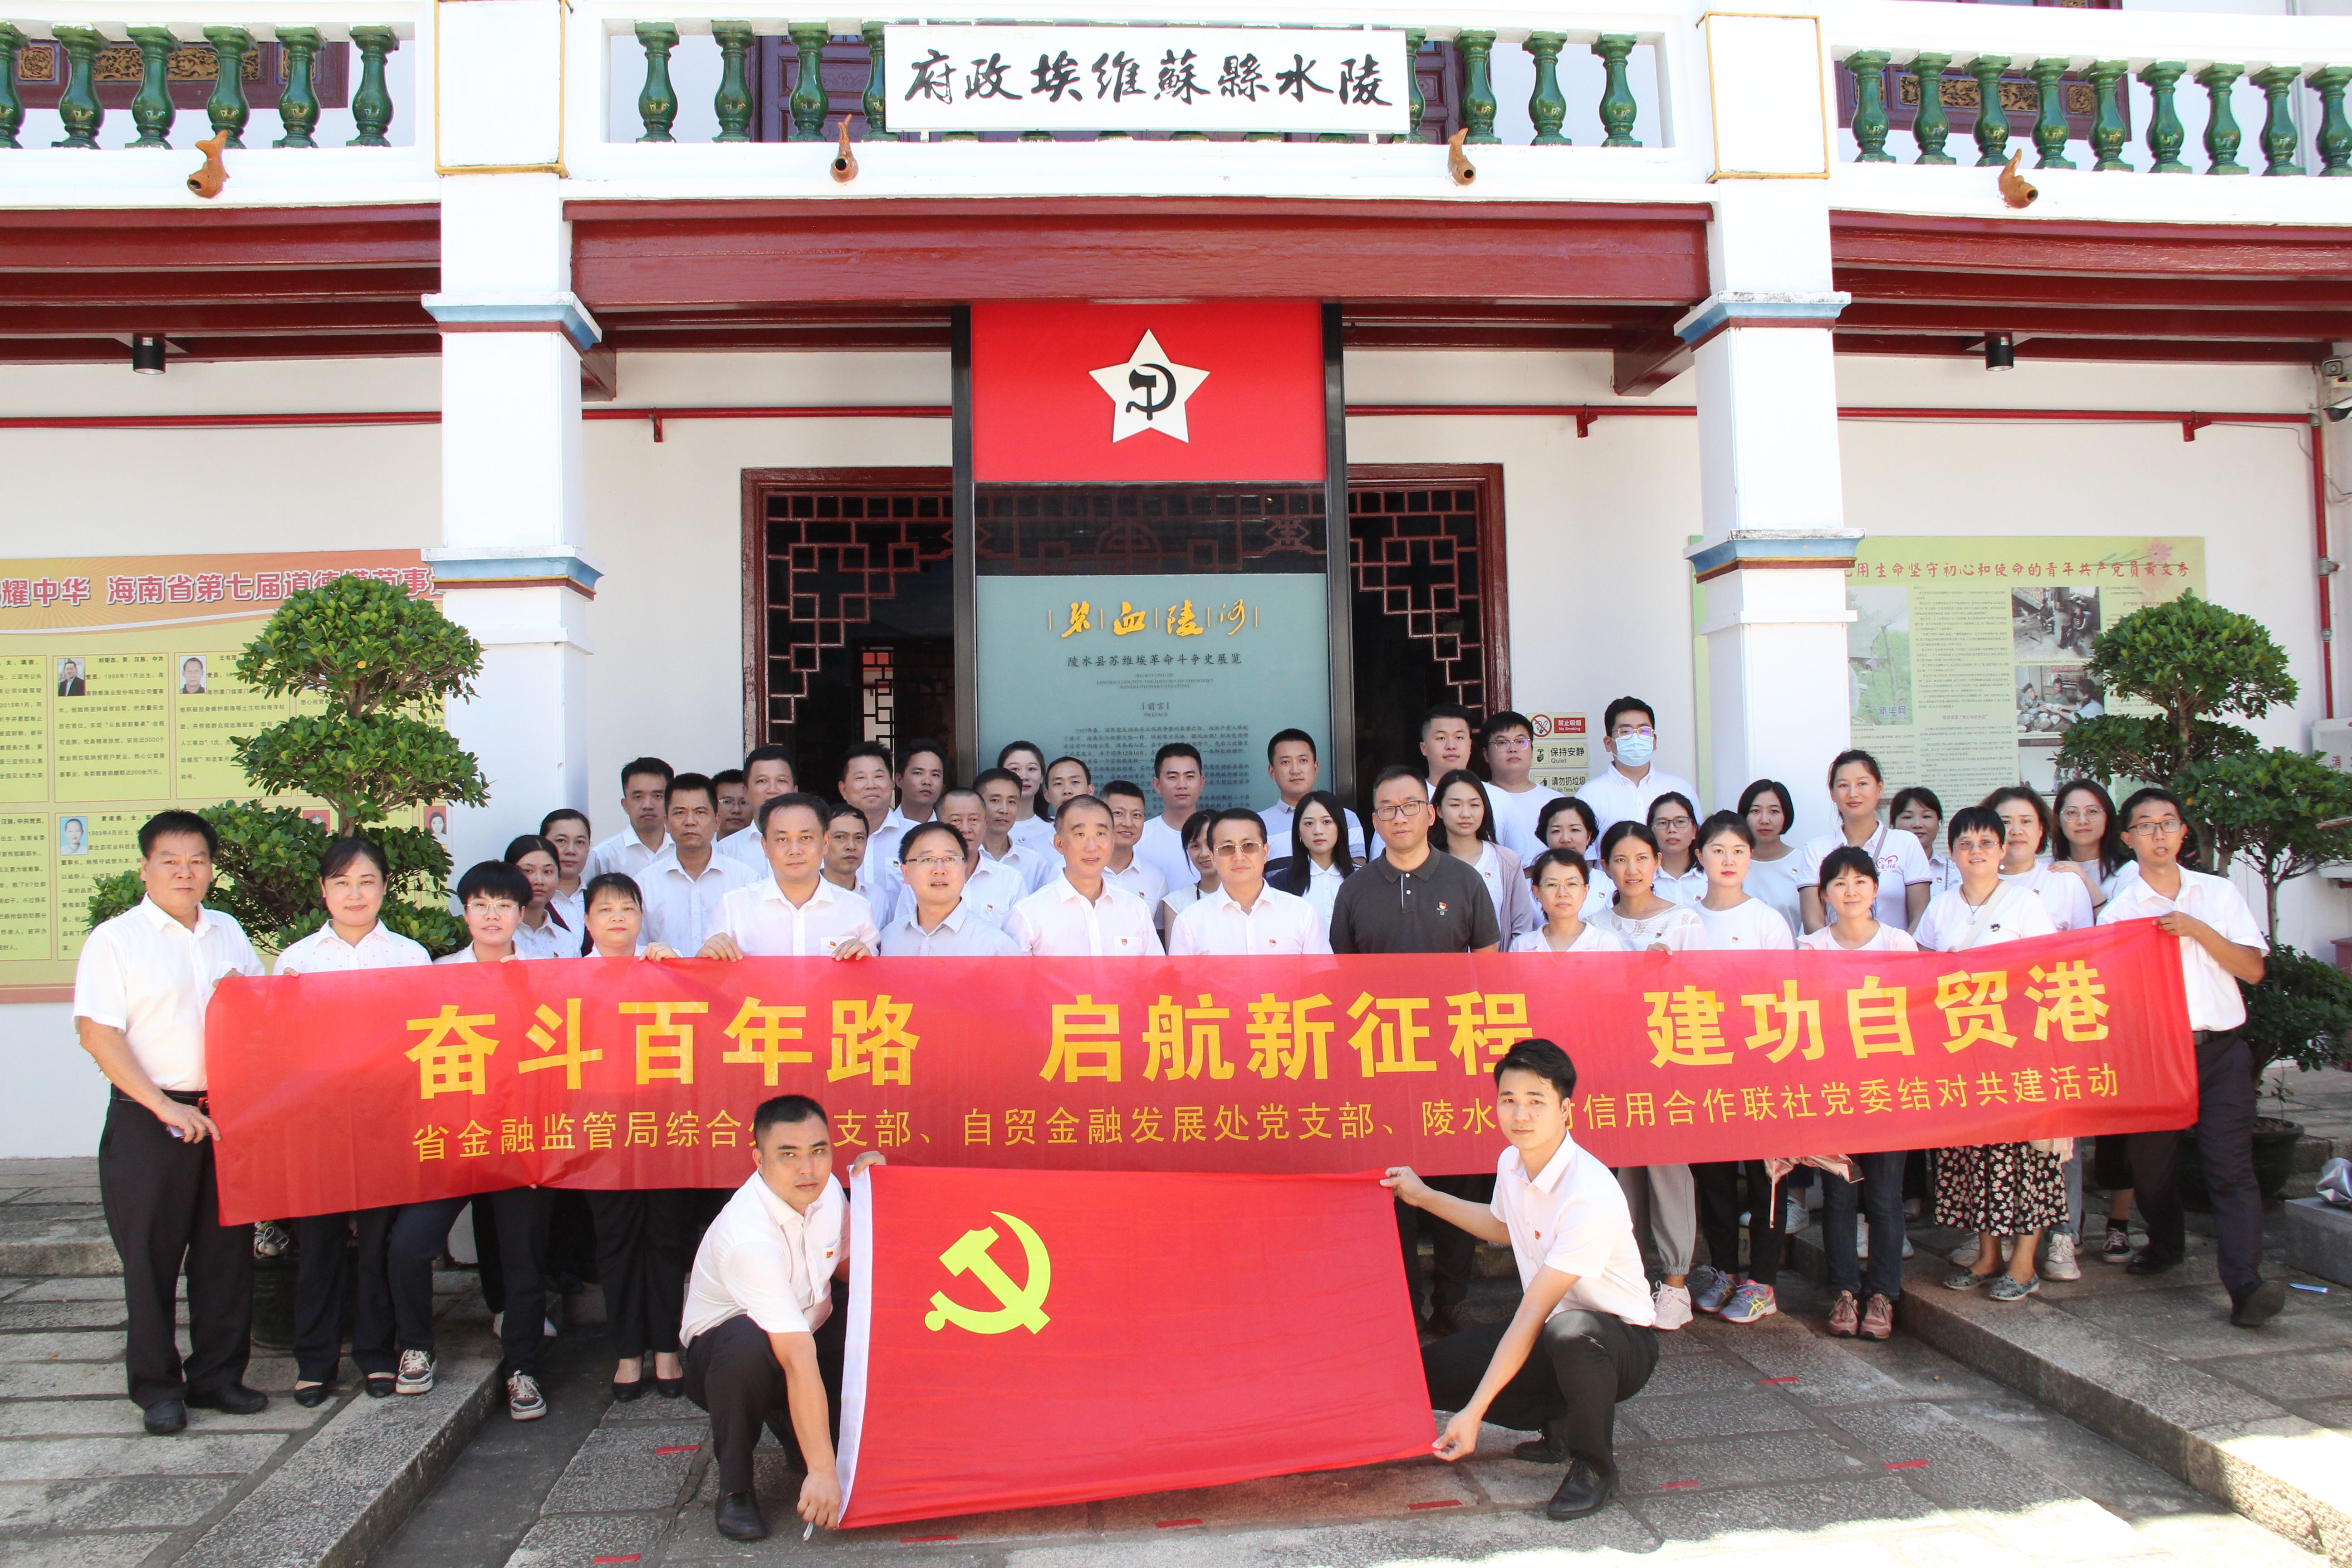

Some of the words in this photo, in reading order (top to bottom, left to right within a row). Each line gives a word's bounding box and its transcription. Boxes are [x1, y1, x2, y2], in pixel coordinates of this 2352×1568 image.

[1068, 653, 1242, 667] 陵水县苏维埃革命斗争史展览
[1148, 702, 1164, 710] 前言
[1879, 706, 1906, 716] 新华网
[1550, 747, 1584, 757] 保持安静
[1552, 776, 1586, 786] 请勿扔垃圾
[404, 994, 921, 1100] 奋斗百年路
[1039, 991, 1534, 1083] 启航新征程
[1643, 960, 2110, 1068] 建功自贸港
